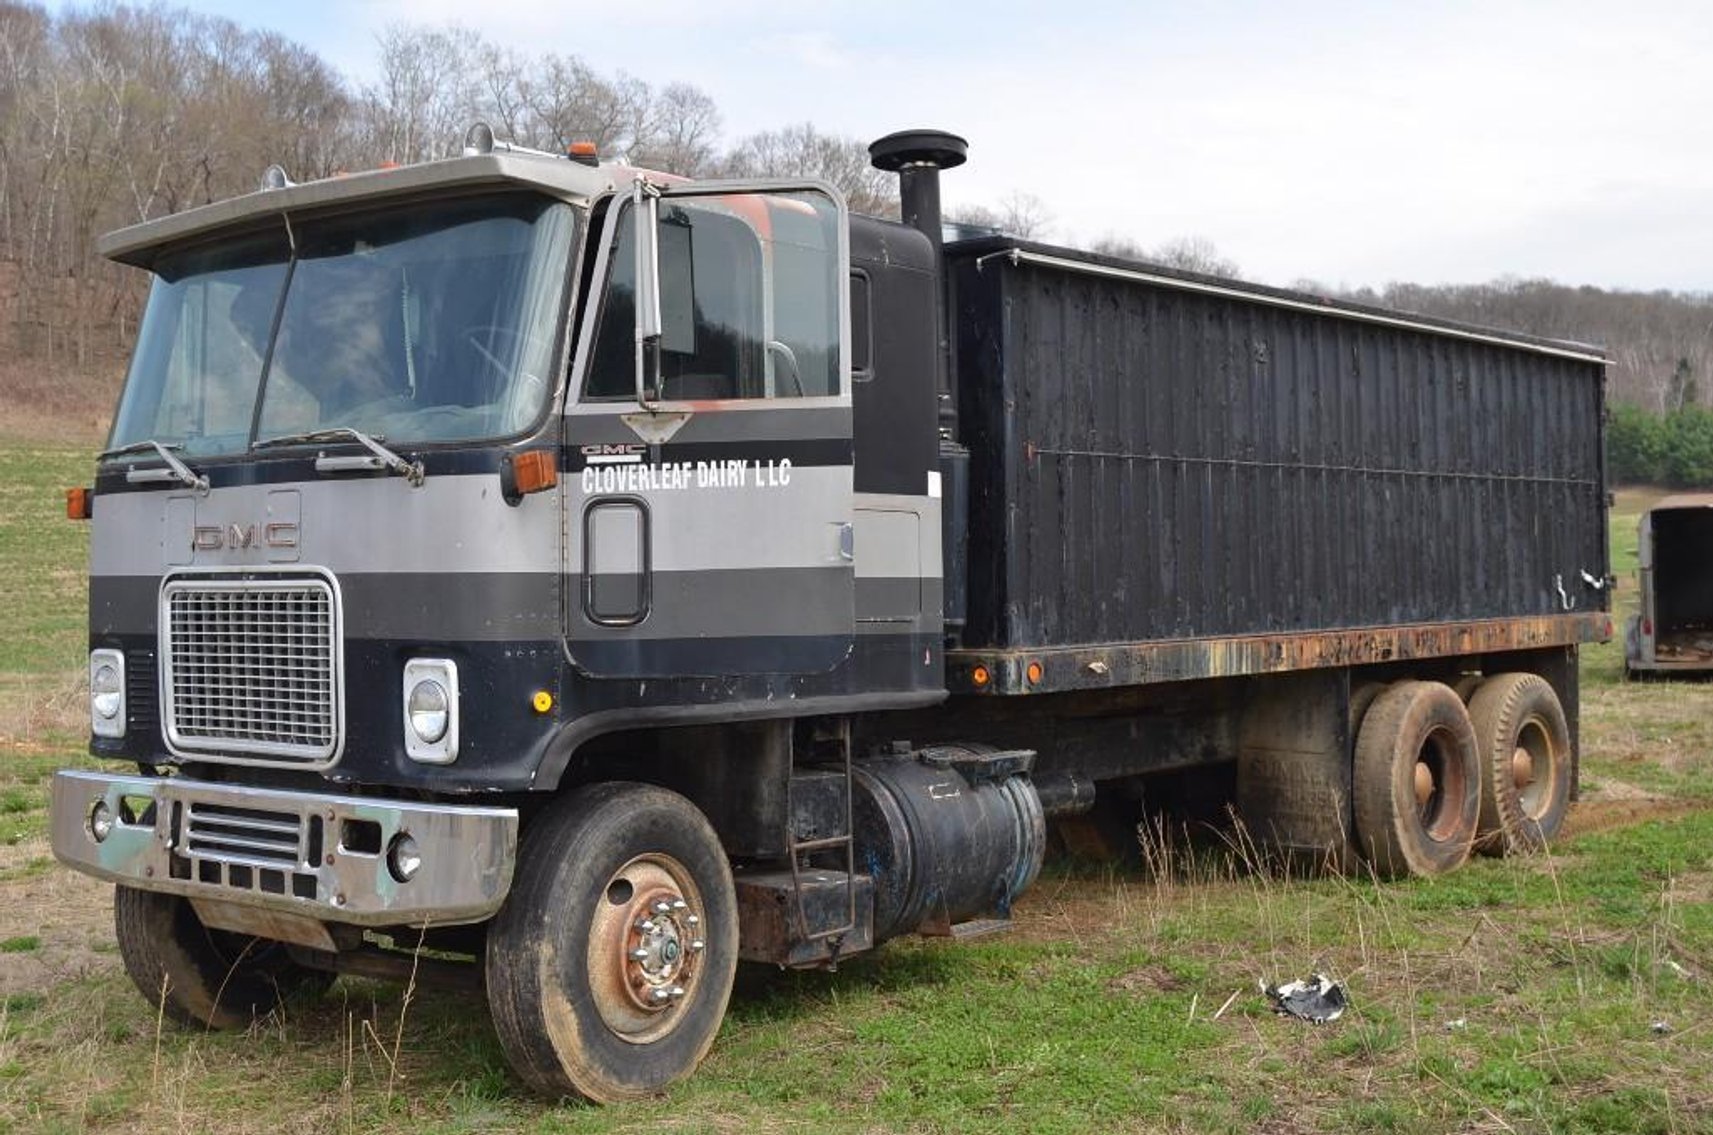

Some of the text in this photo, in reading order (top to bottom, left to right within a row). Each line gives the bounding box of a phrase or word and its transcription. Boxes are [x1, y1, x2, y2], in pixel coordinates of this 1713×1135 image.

[581, 444, 647, 455] GMC
[581, 461, 692, 494] CLOVERLEAF
[697, 459, 748, 488] DAIRY
[195, 522, 297, 550] GMC
